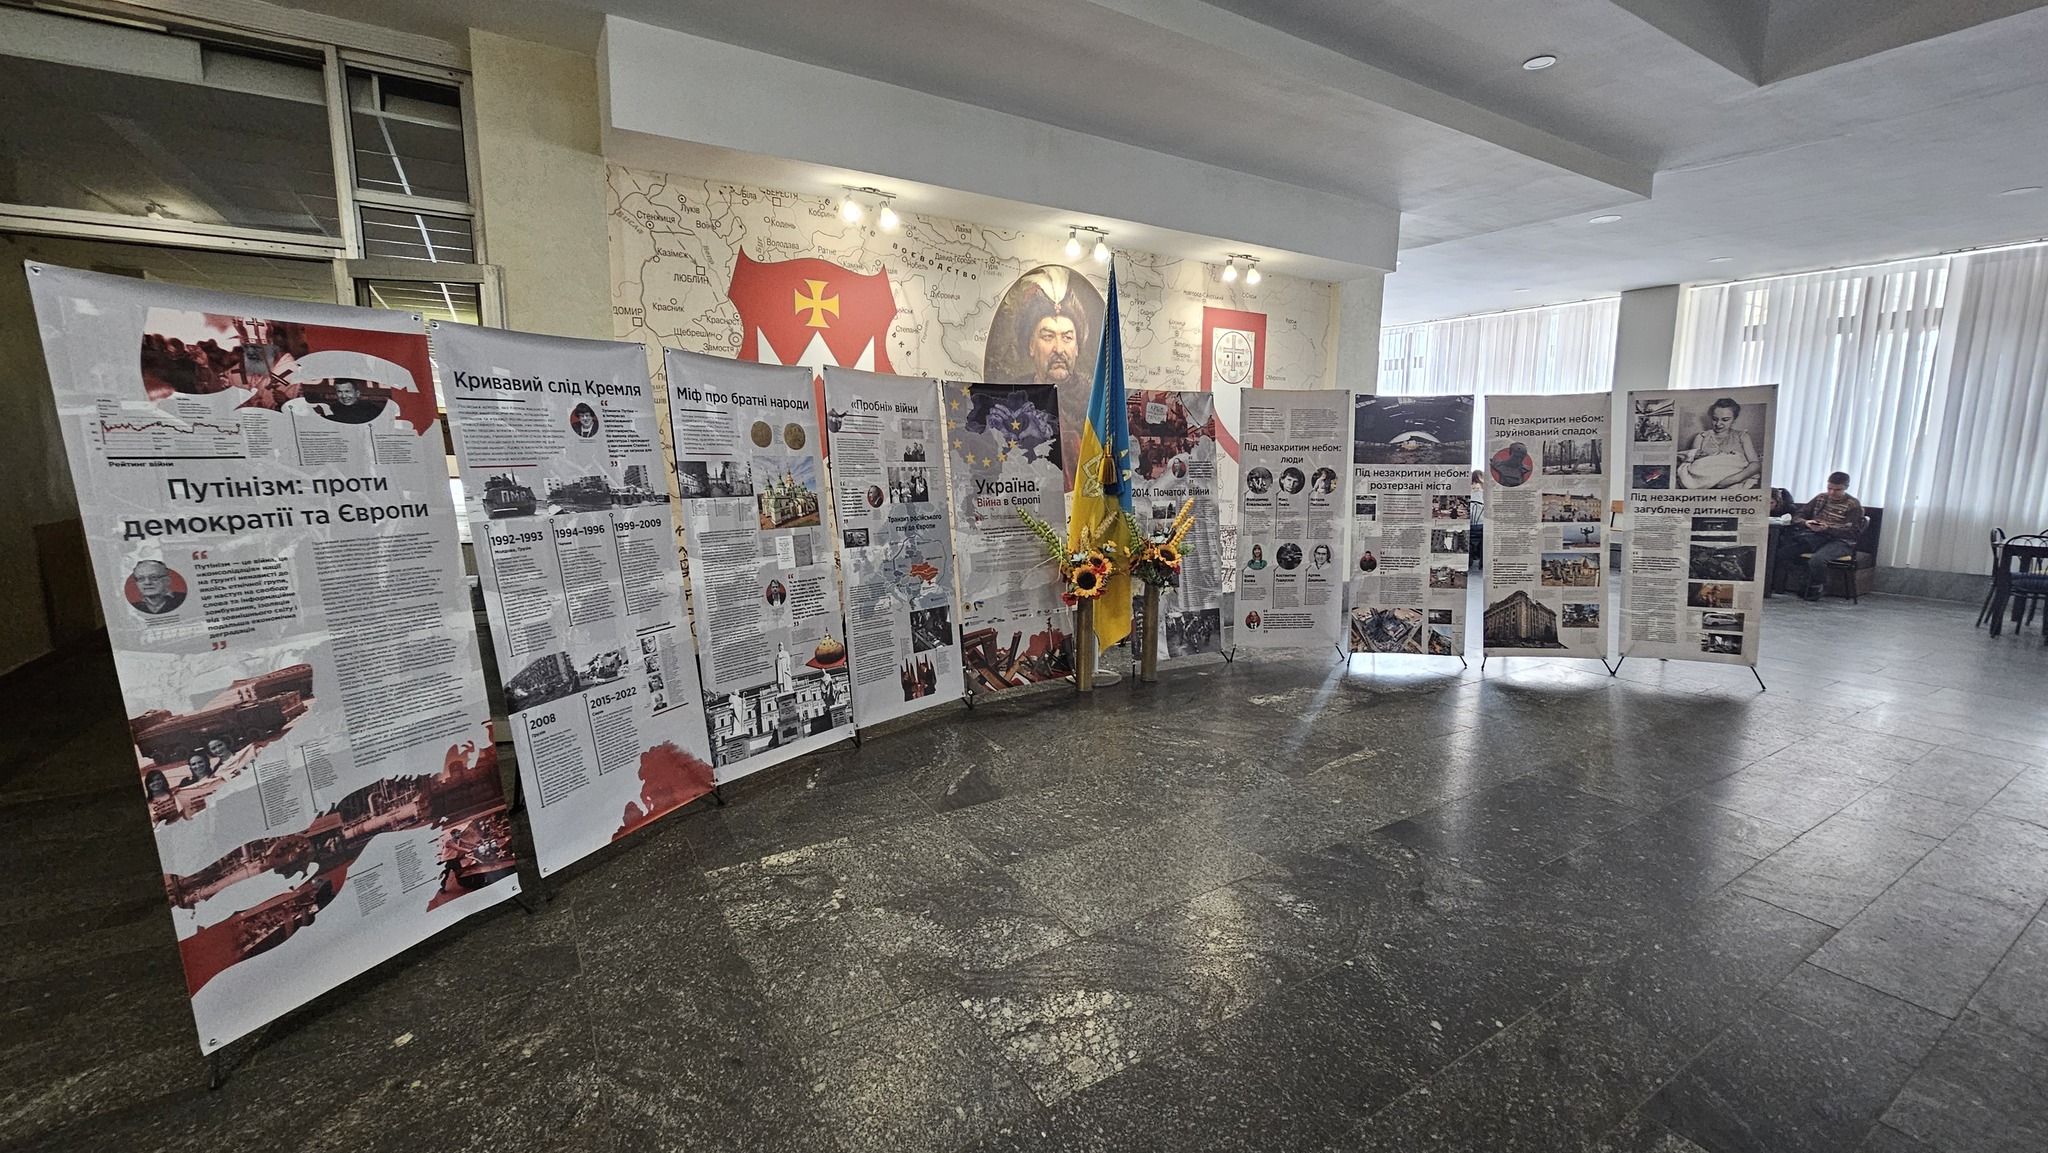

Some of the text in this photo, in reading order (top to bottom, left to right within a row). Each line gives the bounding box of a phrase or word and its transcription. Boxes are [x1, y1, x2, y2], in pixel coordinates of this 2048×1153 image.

[680, 204, 700, 215] Луків
[770, 219, 796, 230] Кодень
[766, 238, 800, 250] Володава
[817, 246, 837, 256] Ратне
[673, 274, 709, 285] ЛЮБЛИН
[652, 302, 685, 313] Красник
[703, 343, 735, 353] Замостя
[454, 371, 641, 397] Кривавий слід Кремля
[677, 387, 809, 410] Міф про братні народи
[851, 400, 918, 413] «Пробні» війни
[1490, 415, 1604, 425] Під незакритим небом:
[1495, 427, 1597, 438] зруйнований спадок
[1245, 443, 1341, 452] Під незакритим небом:
[1281, 456, 1303, 464] люди
[1355, 468, 1469, 478] Під незакритим небом:
[168, 476, 388, 504] Путінізм: проти
[976, 478, 1039, 496] Україна.
[1132, 487, 1209, 497] 2014. Початок війни
[1370, 482, 1451, 491] розтерзані міста
[977, 498, 1001, 508] Війна
[1011, 495, 1040, 506] Європі
[1631, 493, 1762, 502] Під незакритим небом:
[1634, 506, 1755, 515] загублене дитинство
[123, 502, 428, 541] демократії та Європи
[615, 519, 661, 532] 1999-2009
[916, 523, 935, 531] Європи
[555, 524, 605, 538] 1994-1996
[491, 531, 543, 546] 1992-1993
[194, 562, 230, 570] Путінізм
[214, 591, 242, 599] наступ
[590, 687, 637, 709] 2015-2022
[529, 713, 556, 730] 2008
